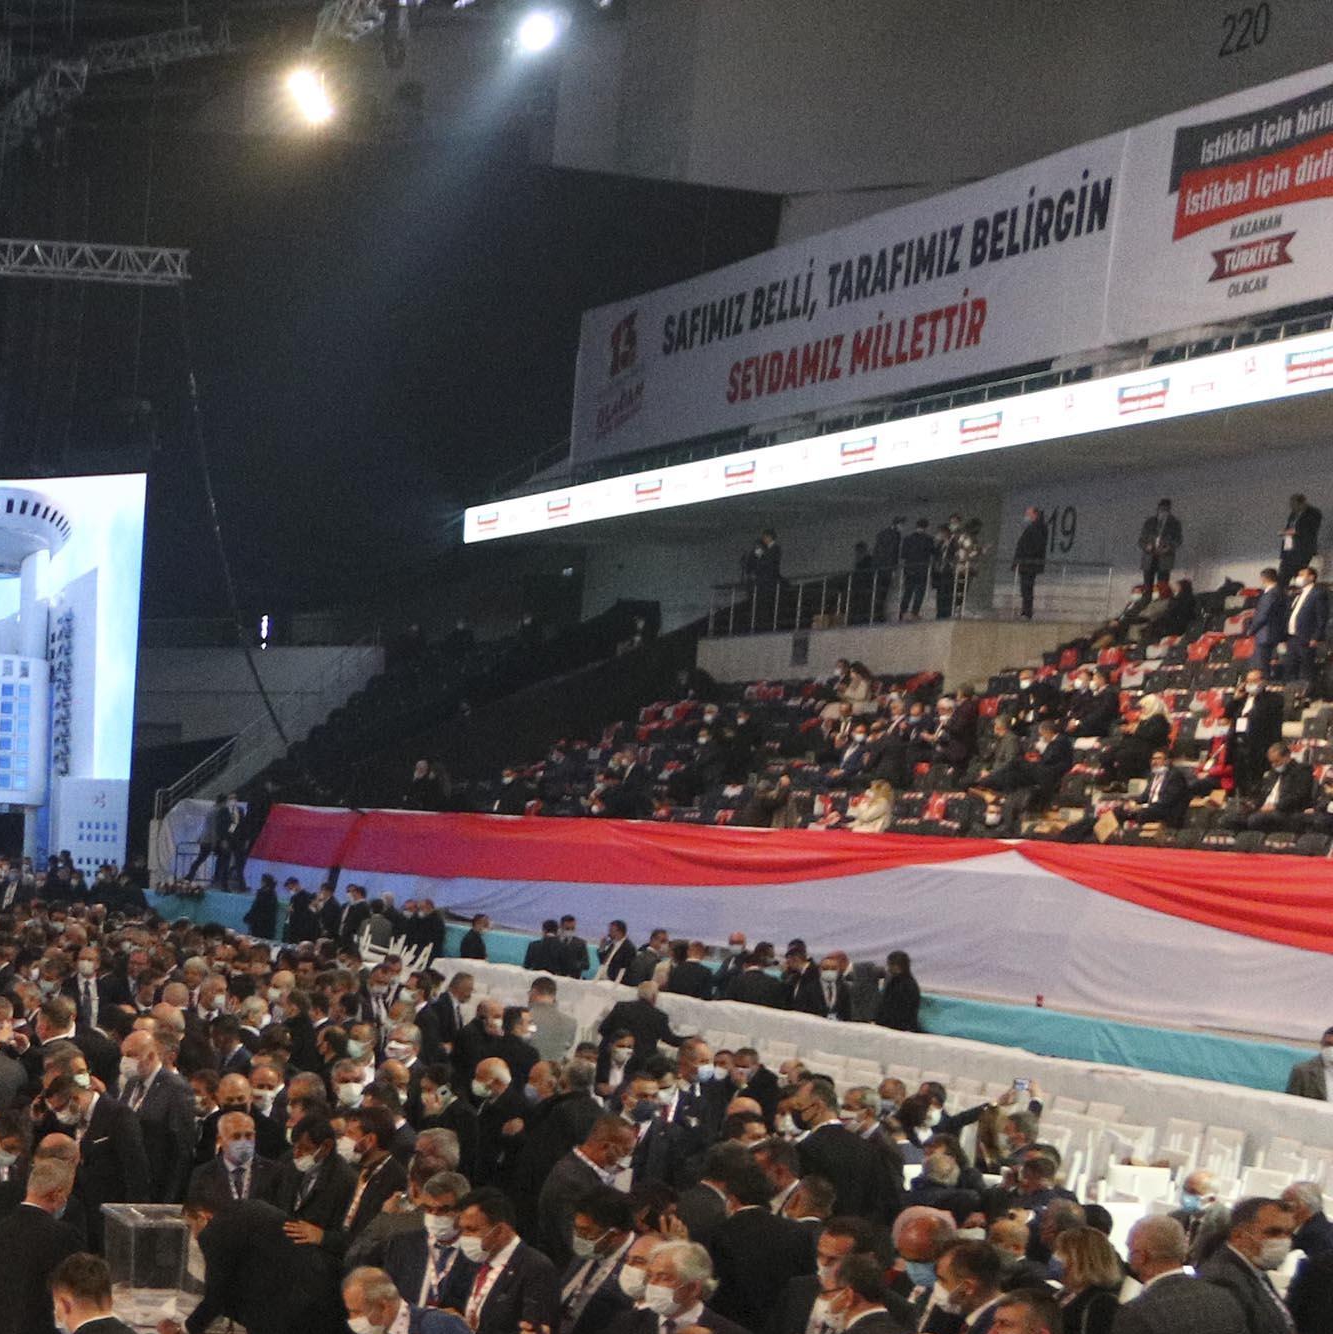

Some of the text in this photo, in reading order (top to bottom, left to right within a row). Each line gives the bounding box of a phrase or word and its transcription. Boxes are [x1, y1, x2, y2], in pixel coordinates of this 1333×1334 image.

[1219, 3, 1269, 58] 220
[1200, 123, 1257, 164] istiklal
[1260, 115, 1291, 145] için
[1184, 172, 1251, 217] istikbal
[1254, 164, 1290, 198] için
[662, 169, 1113, 355] SAFIMIZ BELLİ, TARAFIMIZ BELİRGİN
[1223, 239, 1280, 273] TÜRKİYE
[726, 288, 988, 404] SEVDAMIZ MİLLETTİR
